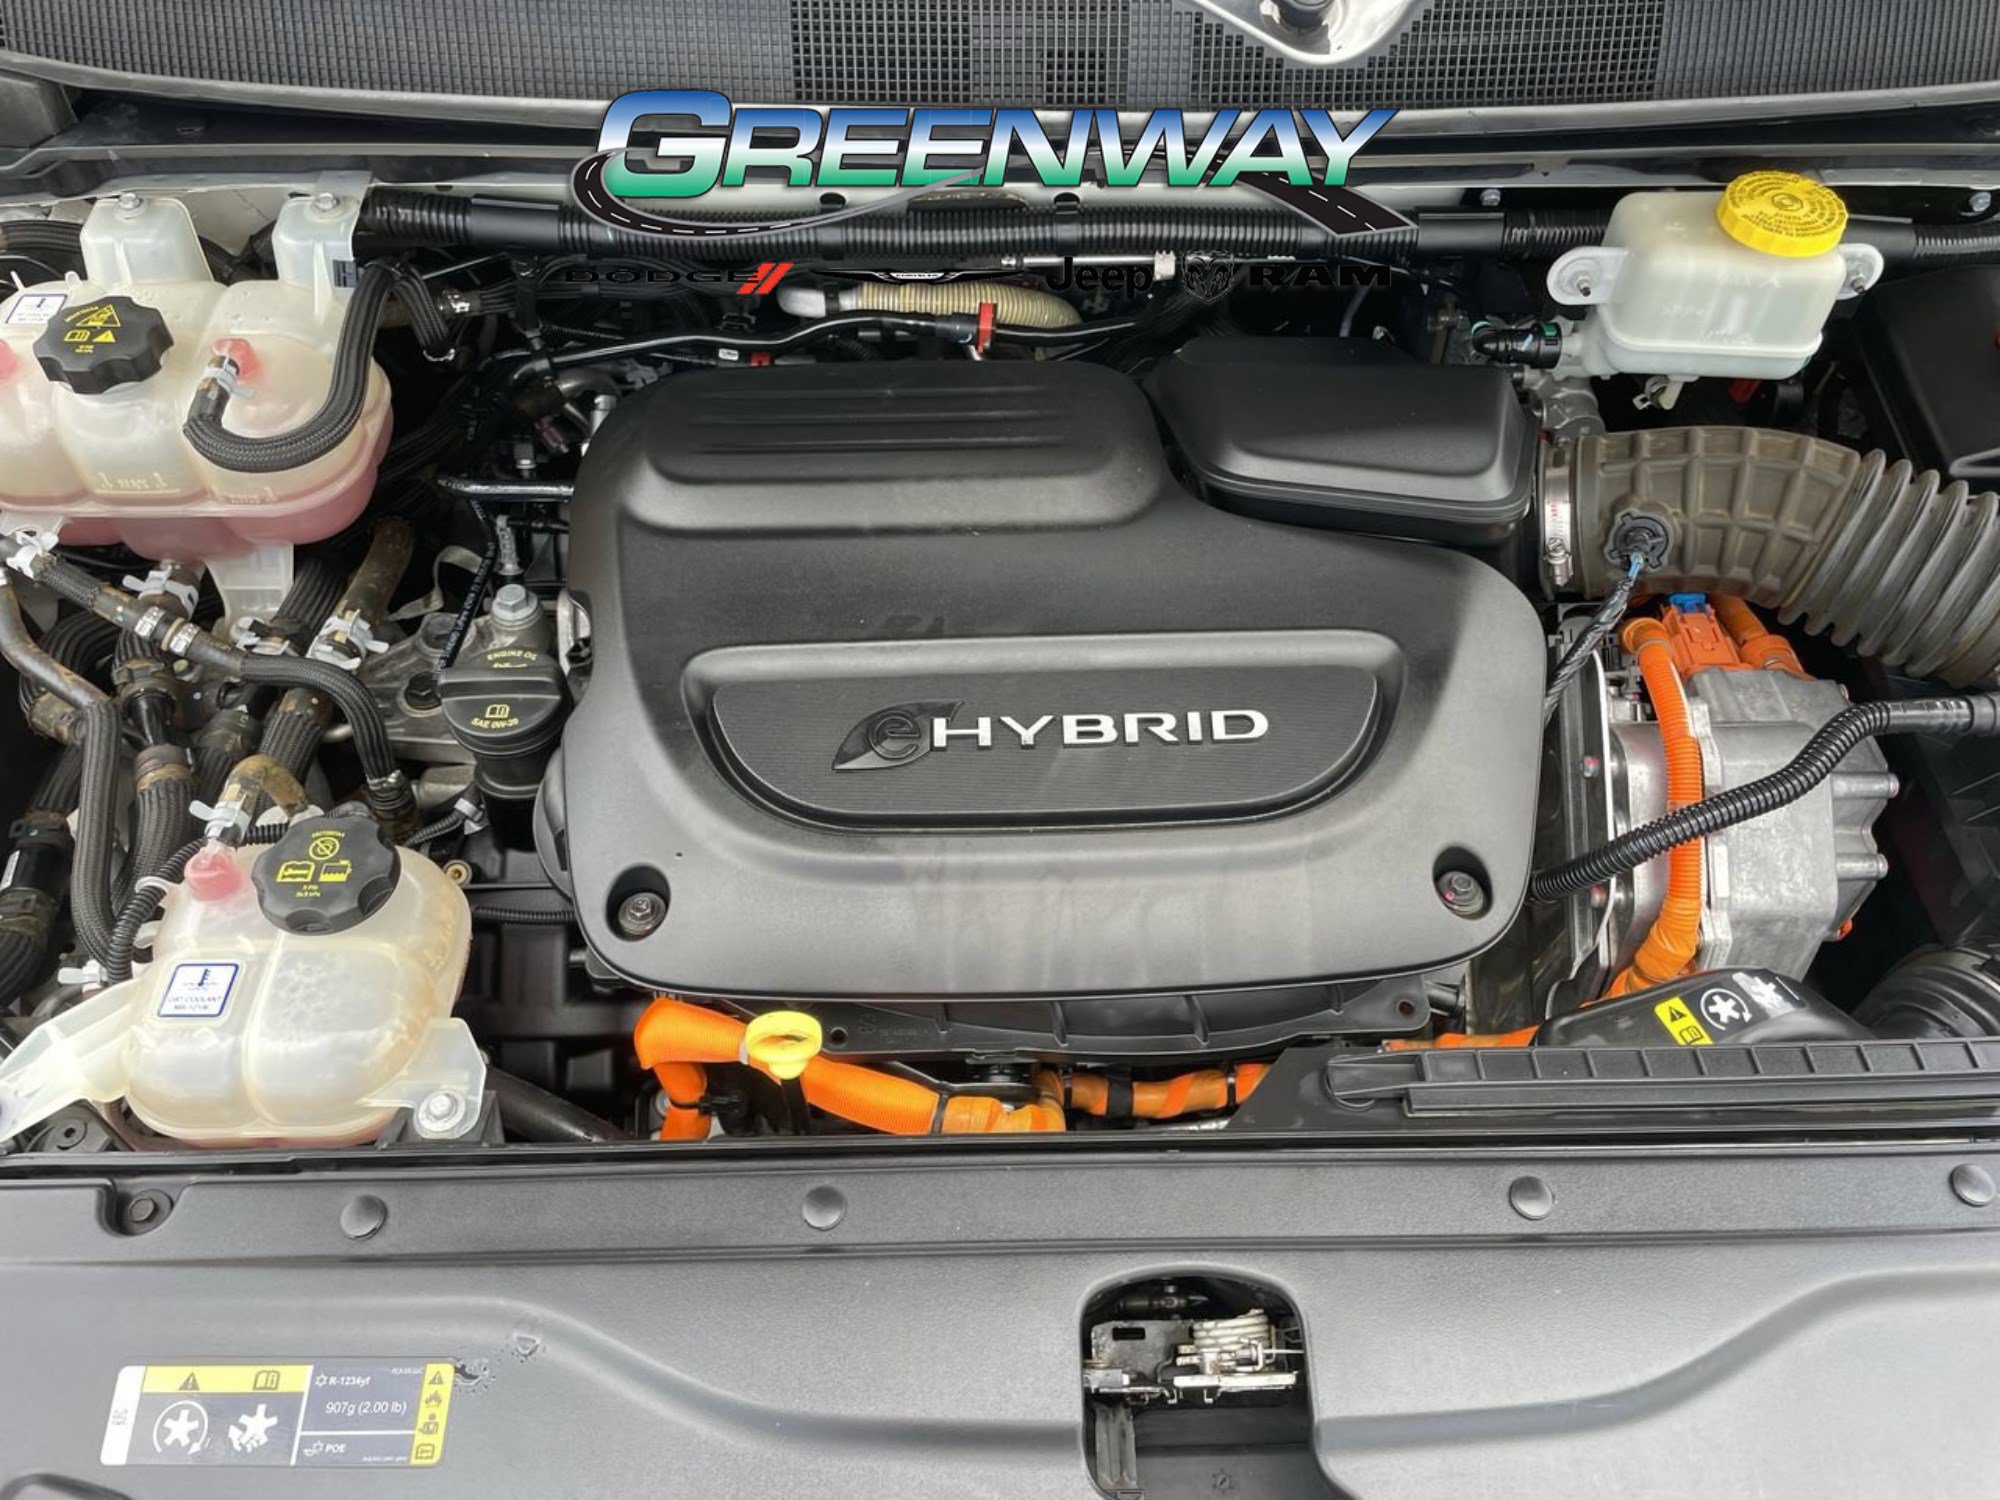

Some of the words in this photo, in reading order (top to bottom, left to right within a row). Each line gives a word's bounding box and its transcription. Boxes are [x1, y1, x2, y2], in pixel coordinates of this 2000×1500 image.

[487, 650, 523, 661] ENGINE
[328, 1376, 372, 1388] R-1234yf
[326, 1401, 356, 1416] 907g
[358, 1400, 389, 1416] (2.00
[390, 1400, 408, 1415] lb)
[325, 1443, 346, 1454] POE
